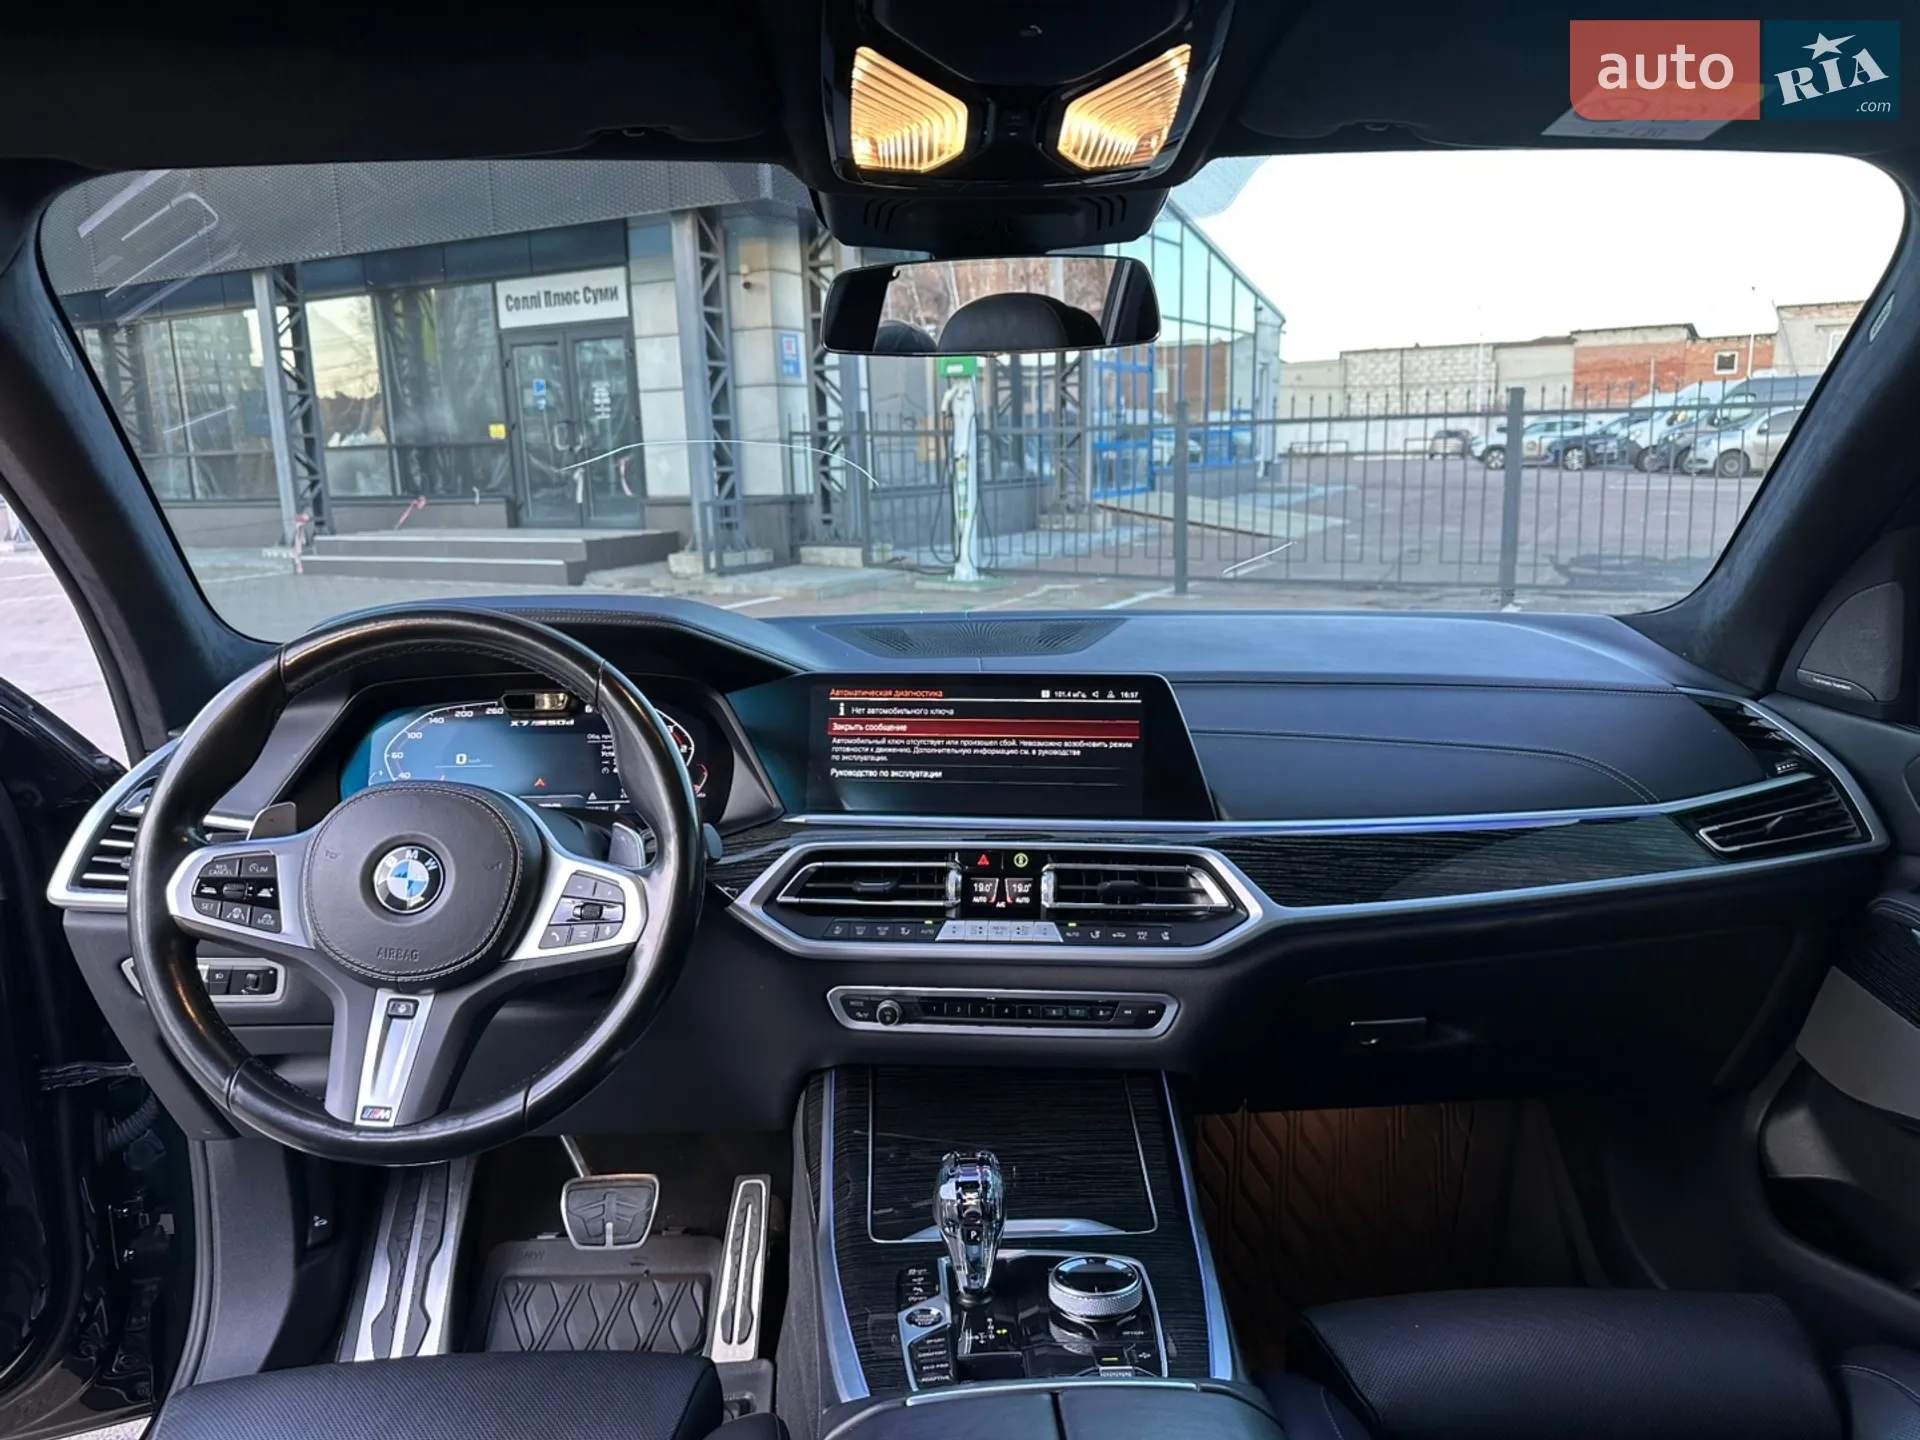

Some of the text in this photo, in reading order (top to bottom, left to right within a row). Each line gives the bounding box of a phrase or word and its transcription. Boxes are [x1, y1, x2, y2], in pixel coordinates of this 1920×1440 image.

[544, 289, 581, 308] Плюс
[582, 285, 619, 305] Суми
[829, 688, 943, 698] Автоматическая диагностика
[454, 710, 474, 718] 200
[851, 706, 955, 716] Нет автомобильного ключа
[832, 722, 908, 733] Закрыть сообщение
[831, 737, 886, 745] Автомобильный
[1019, 740, 1062, 748] Невозможно
[913, 746, 972, 755] Дополнительную
[973, 748, 1019, 756] информацию
[455, 753, 467, 765] 0
[830, 768, 878, 778] Руководство
[890, 770, 943, 779] эксплуатации
[384, 849, 439, 871] BMW
[1015, 896, 1031, 904] AUTO
[376, 946, 420, 962] AIRBAG
[920, 1374, 951, 1383] ADAPTIVE
